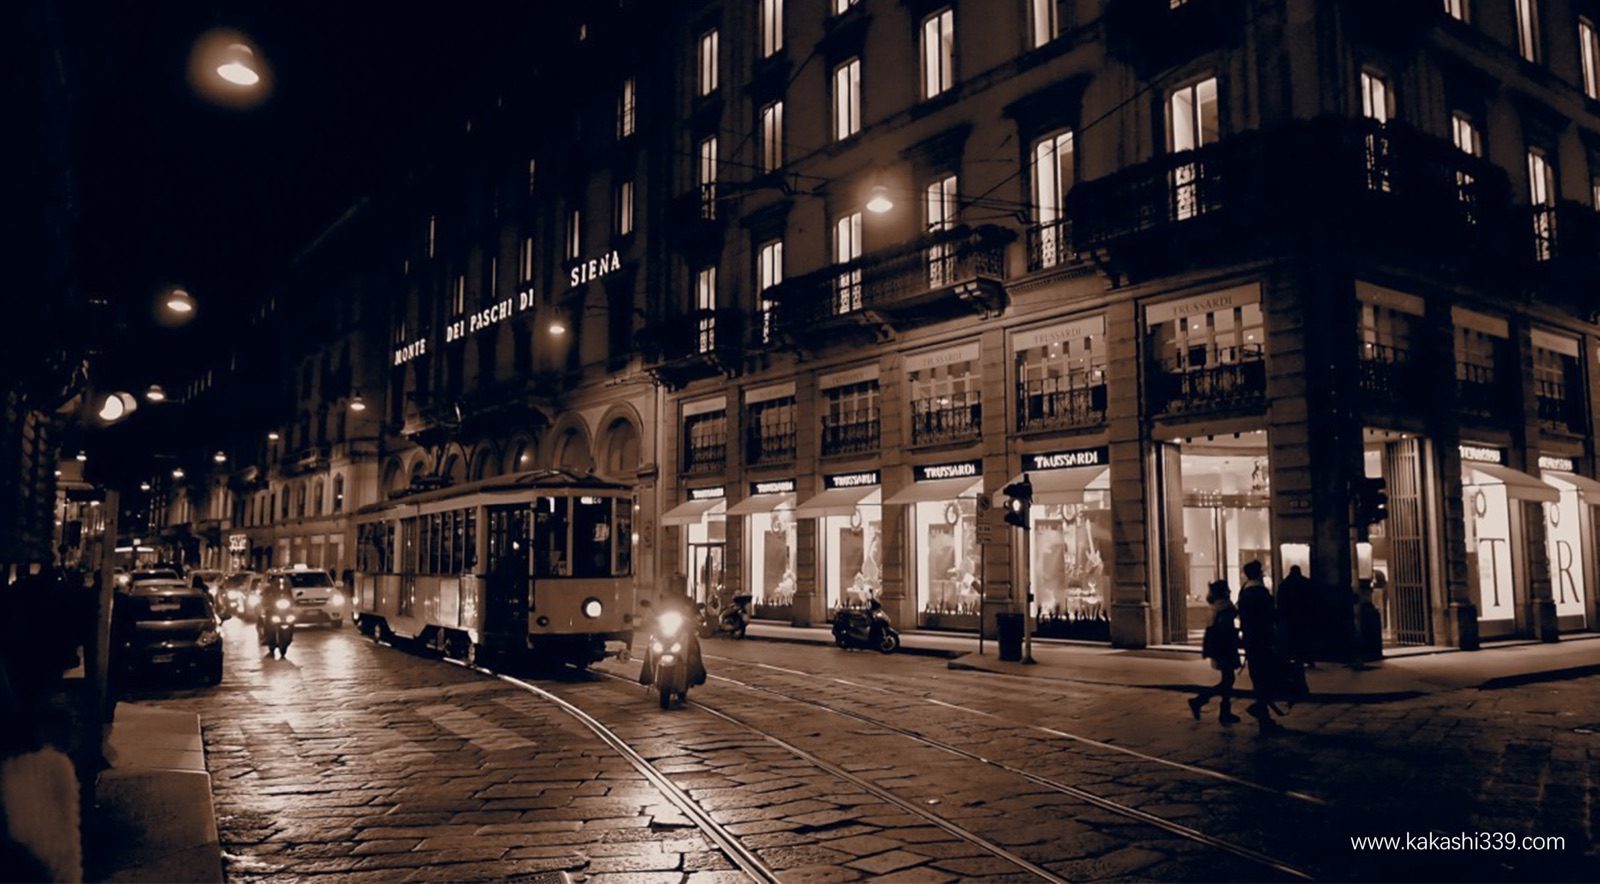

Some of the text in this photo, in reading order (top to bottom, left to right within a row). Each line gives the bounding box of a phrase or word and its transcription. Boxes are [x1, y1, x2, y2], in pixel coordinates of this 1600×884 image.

[394, 250, 620, 366] MONTE DEI PASCHI DI SIENA
[924, 463, 975, 478] TRUSSARDI
[1034, 450, 1098, 469] TRUSSARDI
[1479, 537, 1506, 608] T
[1556, 539, 1581, 605] R
